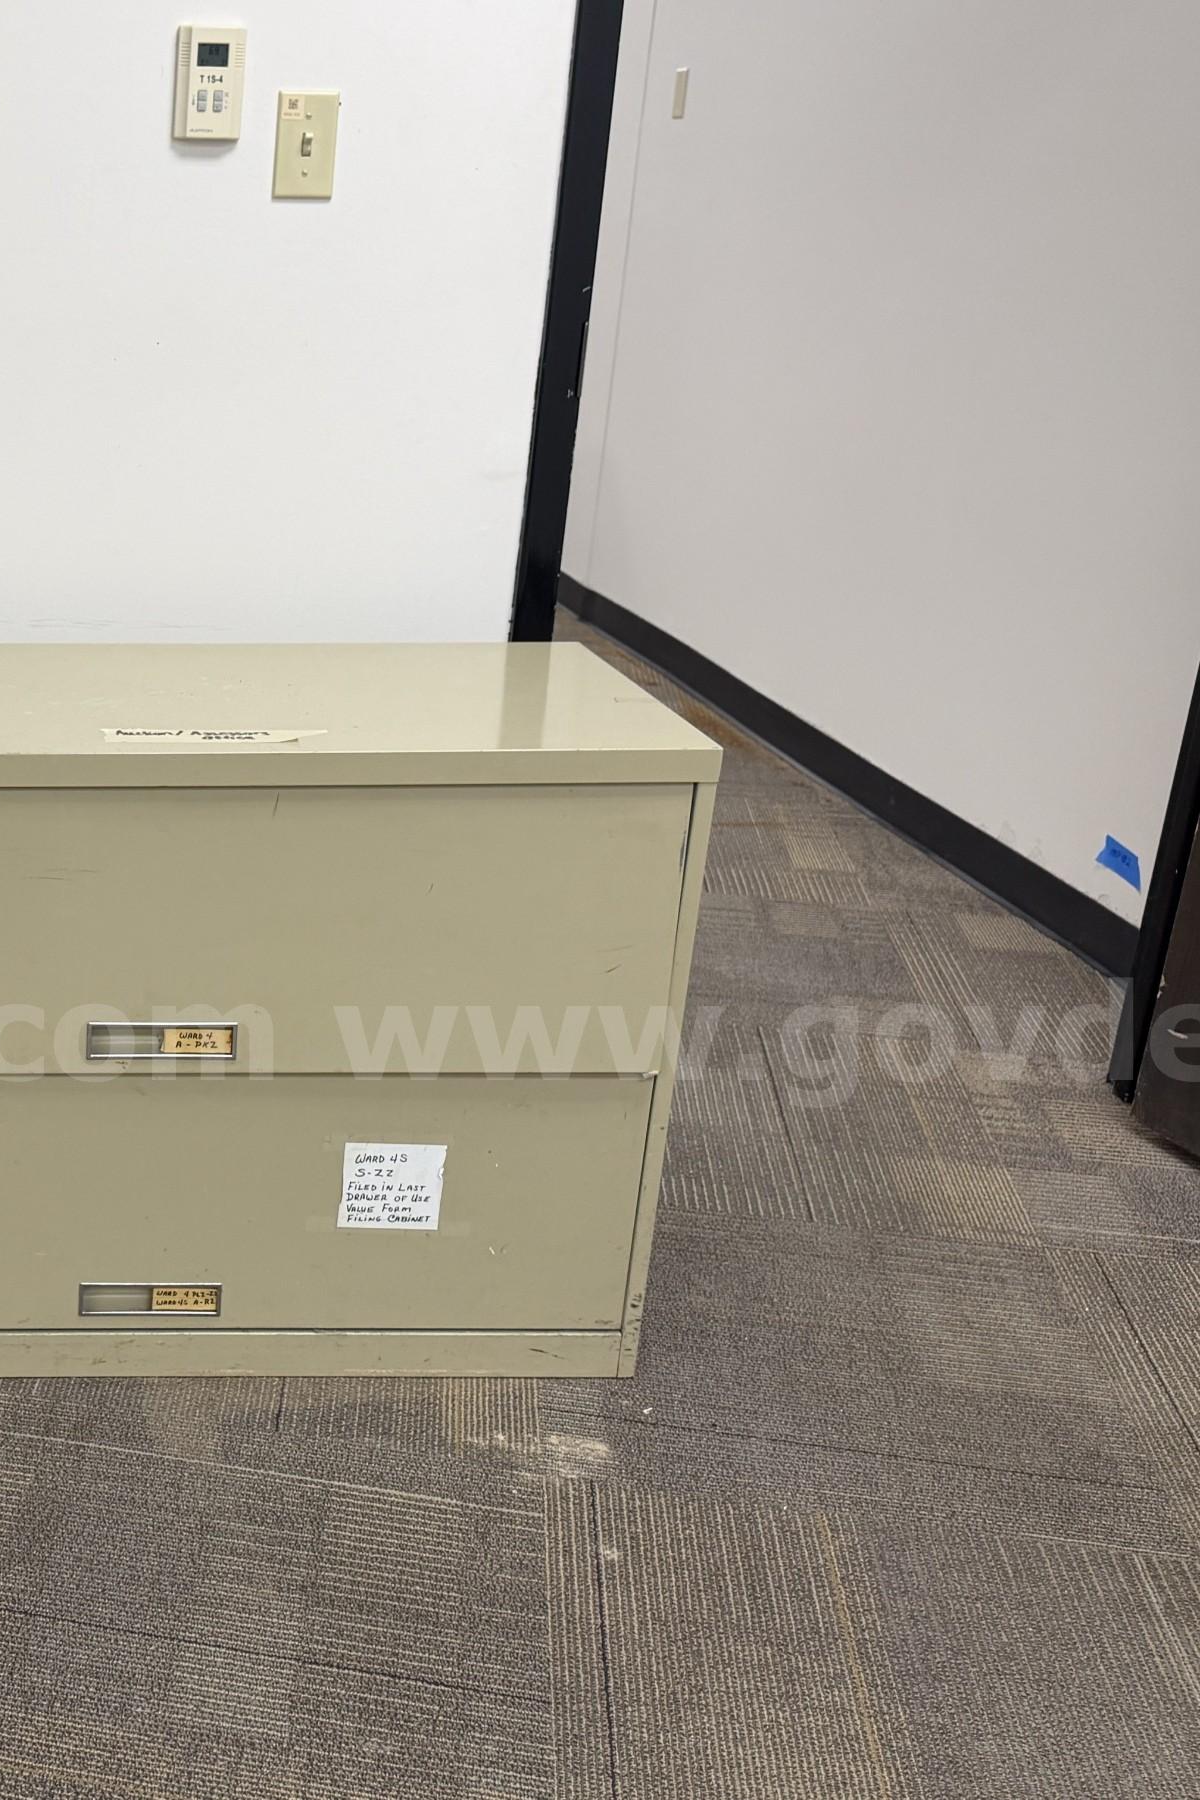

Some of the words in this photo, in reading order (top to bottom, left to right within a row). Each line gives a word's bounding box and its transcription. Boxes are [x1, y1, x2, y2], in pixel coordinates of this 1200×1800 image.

[200, 75, 204, 83] T
[179, 1031, 203, 1040] WARD
[206, 1032, 213, 1040] 4
[355, 1153, 385, 1164] WARD
[398, 1183, 426, 1192] LAST
[346, 1192, 388, 1202] DRAWER
[411, 1193, 431, 1203] USE
[346, 1203, 374, 1213] VALUE
[381, 1203, 412, 1213] FORM
[183, 1290, 189, 1298] 4
